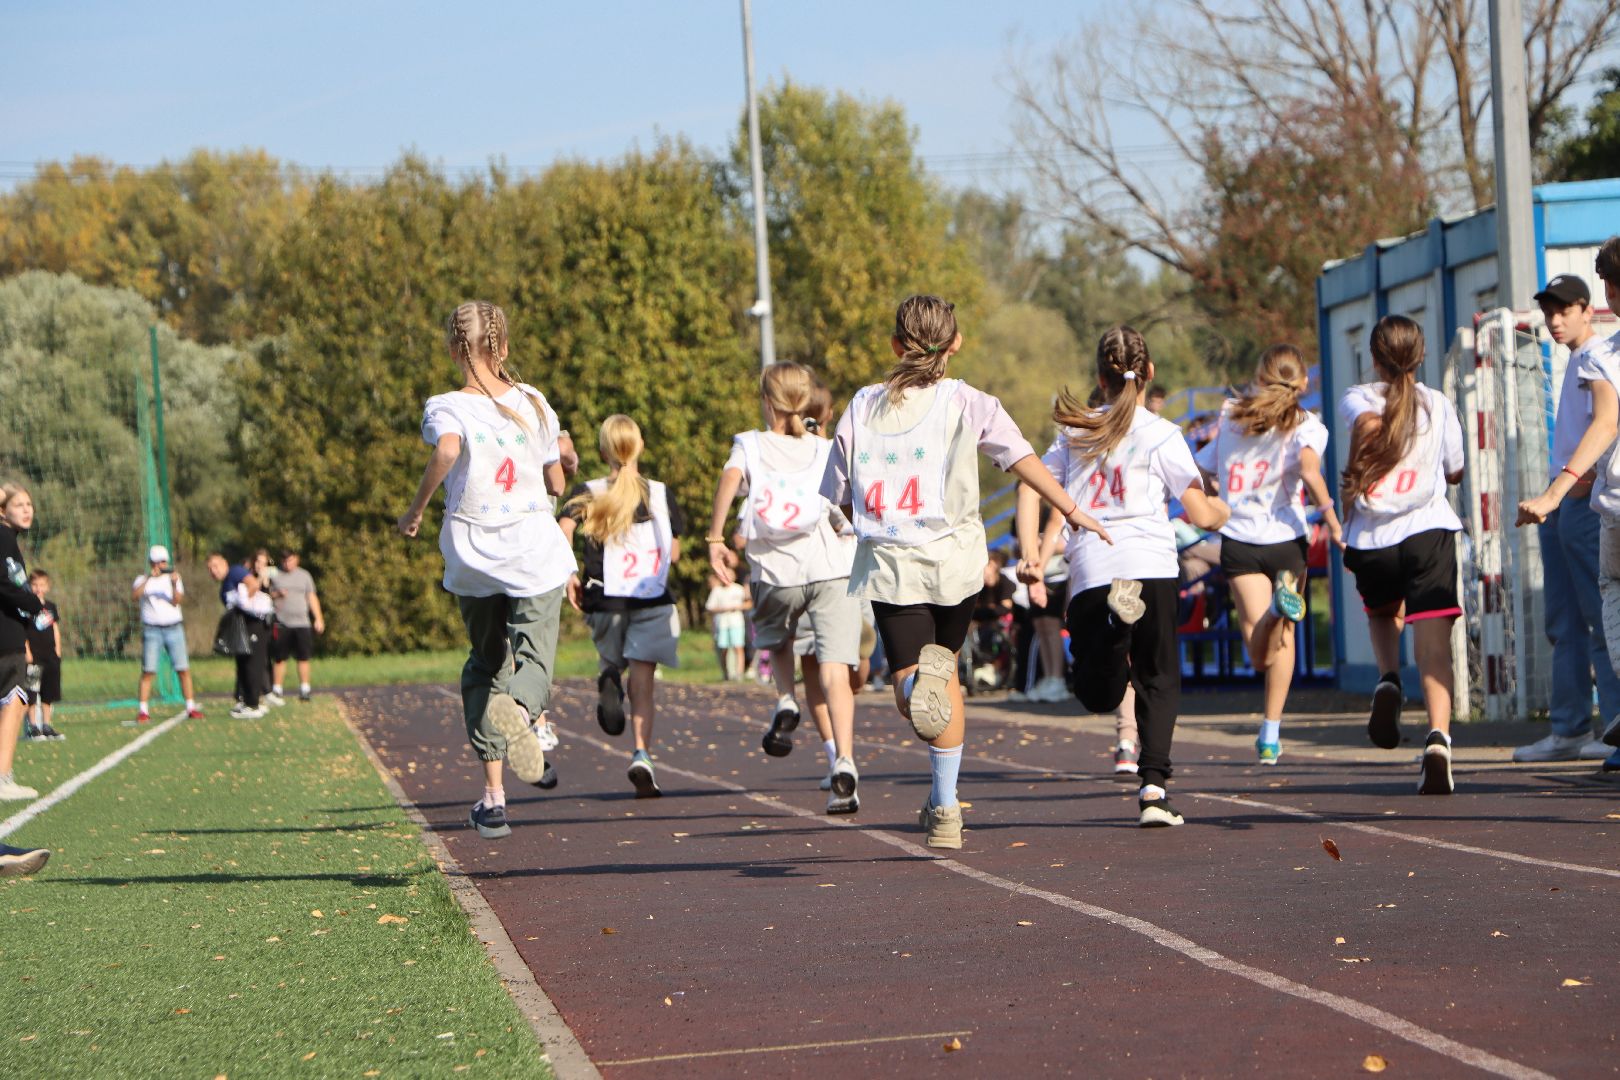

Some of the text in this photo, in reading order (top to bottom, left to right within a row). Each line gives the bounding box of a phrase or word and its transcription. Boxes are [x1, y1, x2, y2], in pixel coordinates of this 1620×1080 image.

[494, 456, 518, 493] 4
[1088, 464, 1126, 510] 24
[1227, 460, 1270, 493] 63
[755, 489, 801, 531] 22
[863, 475, 925, 520] 44
[621, 547, 663, 579] 27
